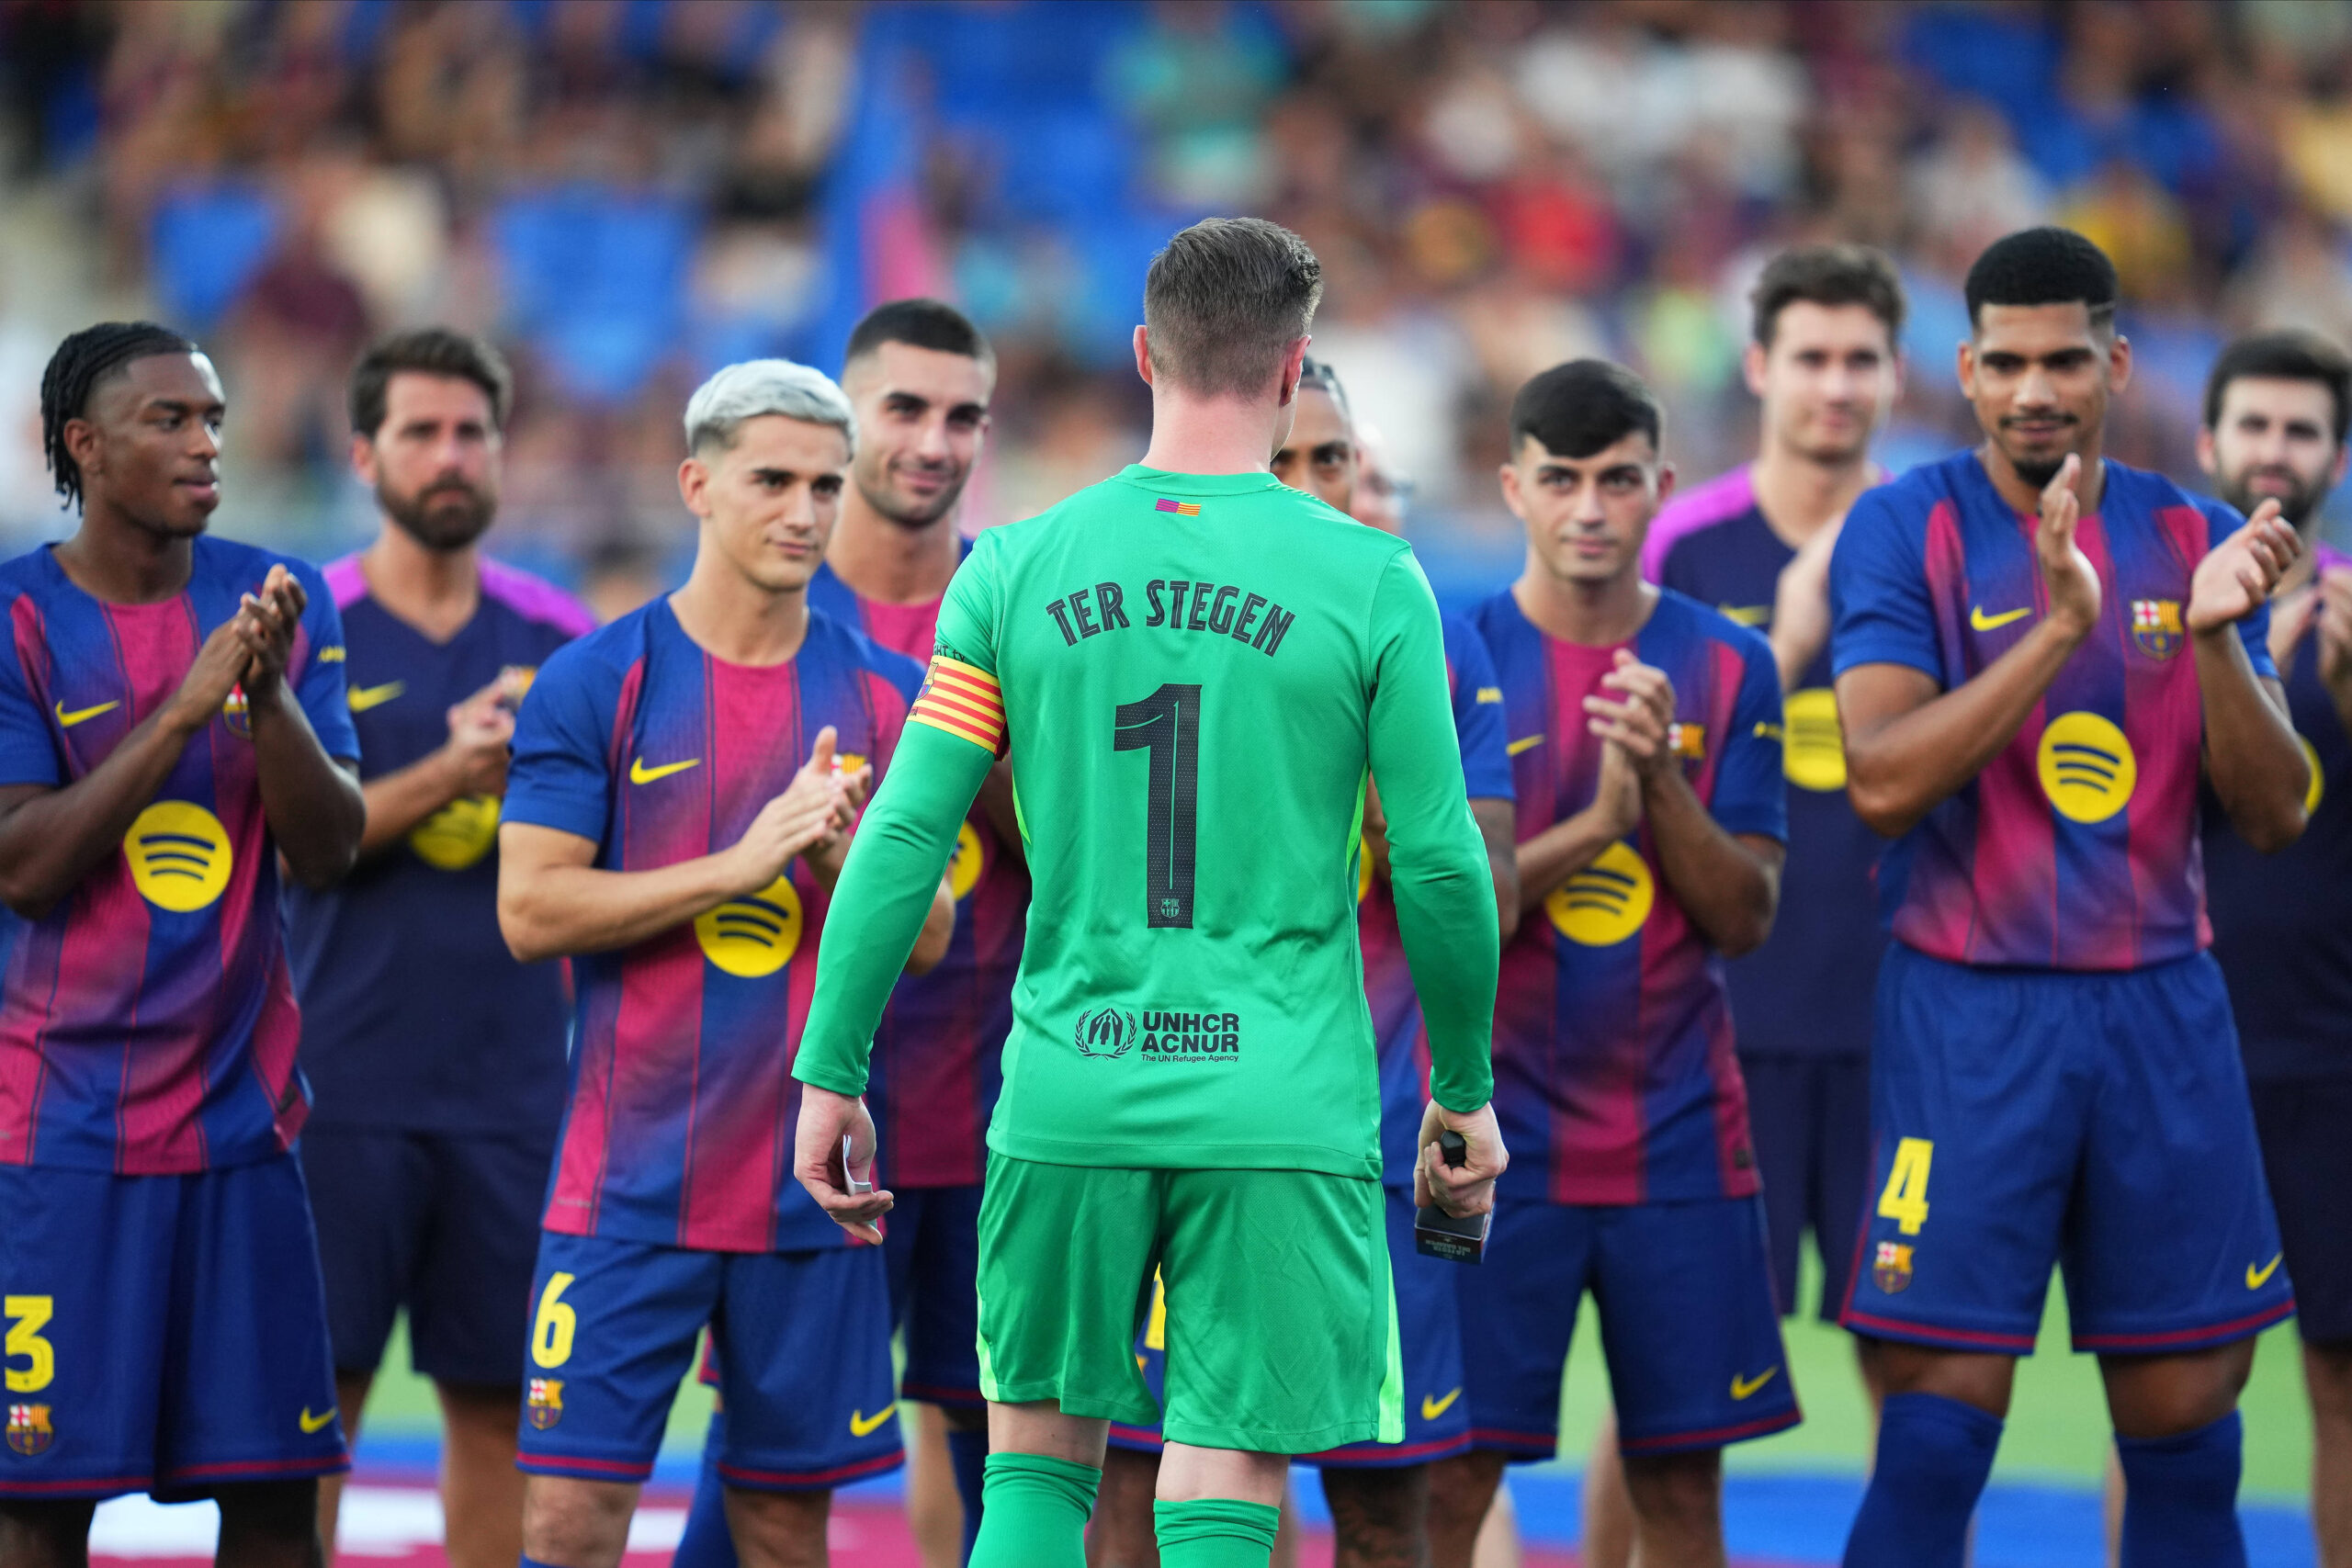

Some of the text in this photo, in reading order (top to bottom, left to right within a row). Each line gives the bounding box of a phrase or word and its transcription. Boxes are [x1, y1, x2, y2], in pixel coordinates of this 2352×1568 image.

[1046, 579, 1296, 658] TER STEGEN
[1114, 683, 1203, 930] 1
[1141, 1033, 1239, 1053] ACNUR
[1141, 1054, 1238, 1064] The UN Refugee Agency
[1143, 1011, 1239, 1033] UNHCR
[1877, 1136, 1934, 1235] 4
[5, 1295, 54, 1393] 3
[531, 1271, 576, 1369] 6
